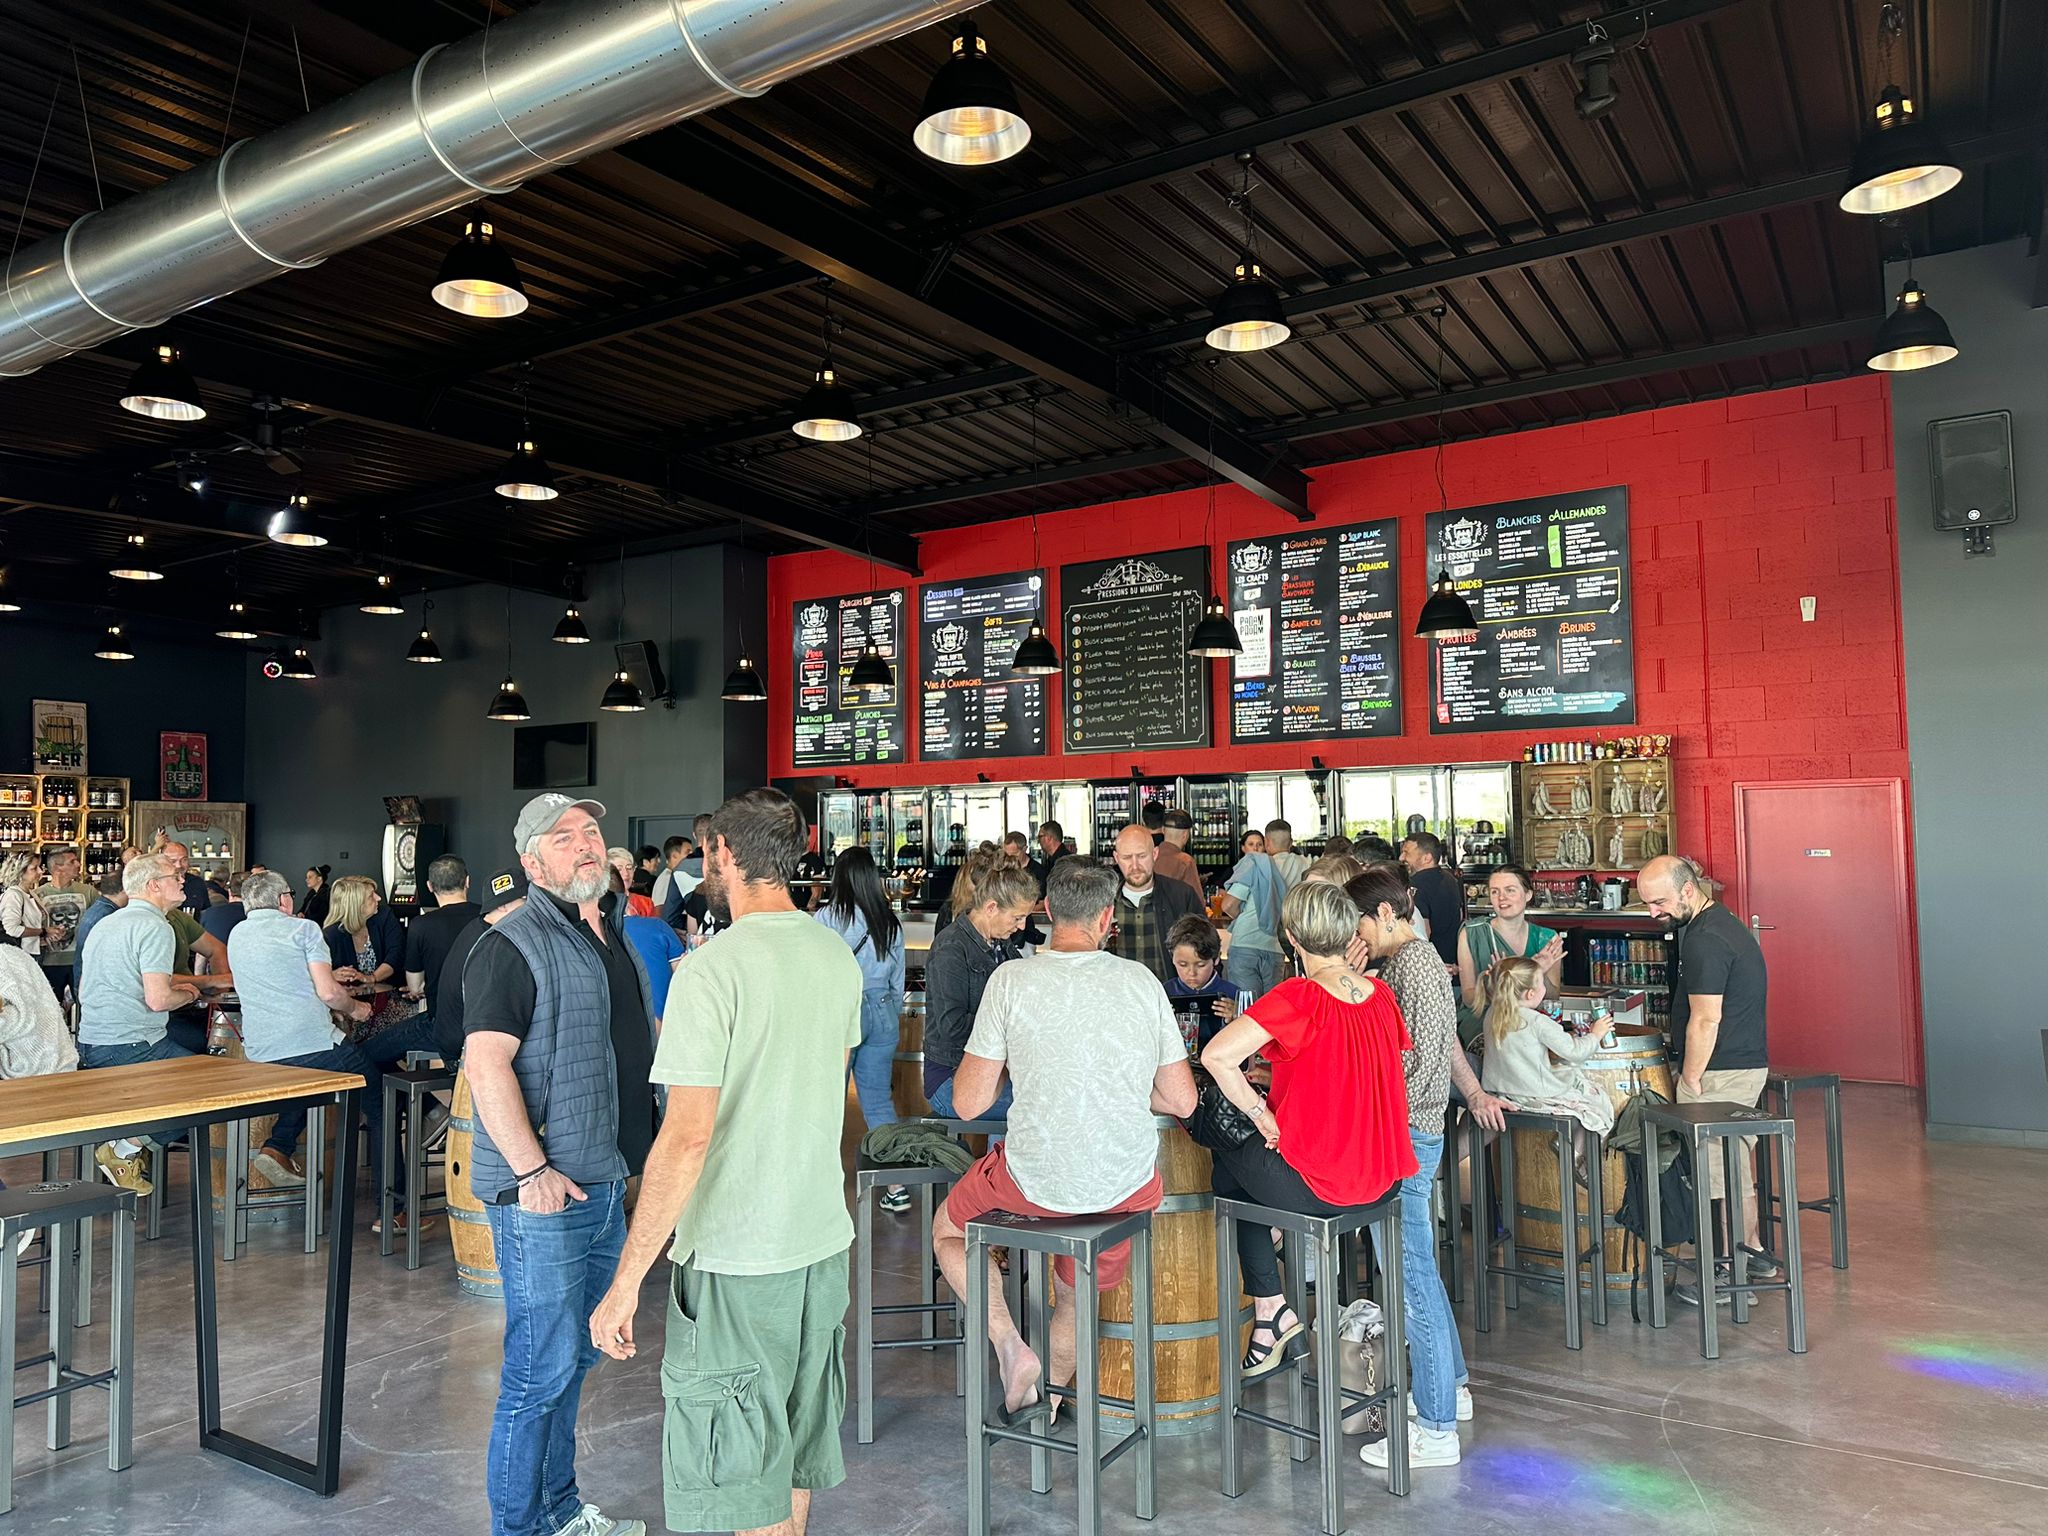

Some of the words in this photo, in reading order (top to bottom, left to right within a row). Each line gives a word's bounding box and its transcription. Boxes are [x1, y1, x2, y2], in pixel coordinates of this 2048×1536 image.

[1549, 505, 1607, 522] ALLEMANDES
[1495, 514, 1542, 529] BLANCHES
[1362, 528, 1381, 540] BLANC
[1289, 539, 1309, 549] GRAND
[1310, 537, 1328, 547] PARIS
[1434, 553, 1447, 563] LES
[1447, 547, 1493, 561] ESSENTIELLES
[1235, 575, 1246, 585] LES
[1246, 573, 1269, 583] CRAFTS
[1281, 579, 1315, 591] BRASSEURS
[926, 589, 954, 600] DESSERTS
[1096, 588, 1129, 601] PRESSIONS
[1129, 587, 1138, 595] DU
[1139, 583, 1164, 594] MOMENT
[839, 598, 863, 609] BURGERS
[1082, 610, 1109, 620] KONRAD
[1356, 610, 1393, 622] NÉBULEUSE
[983, 616, 1003, 627] SOFTS
[1290, 619, 1309, 629] SAINTE
[1309, 618, 1322, 628] CRU
[1496, 627, 1537, 641] AMBRÉES
[1559, 621, 1597, 635] BRUNES
[1350, 653, 1382, 663] BRUSSELS
[1339, 664, 1357, 674] BEER
[1358, 662, 1385, 672] PROJECT
[924, 680, 940, 691] VINS
[940, 678, 946, 689] &
[946, 677, 983, 689] CHAMPAGNES
[1241, 690, 1259, 699] MONDE
[1498, 686, 1526, 699] SANS
[1527, 685, 1557, 698] ALCOOL
[1291, 705, 1320, 714] VOCATION
[1361, 700, 1393, 710] BREWDOG
[800, 715, 823, 724] PARTAGER
[854, 710, 881, 720] PLANCHES
[39, 751, 82, 767] BEER
[165, 770, 203, 783] BEER
